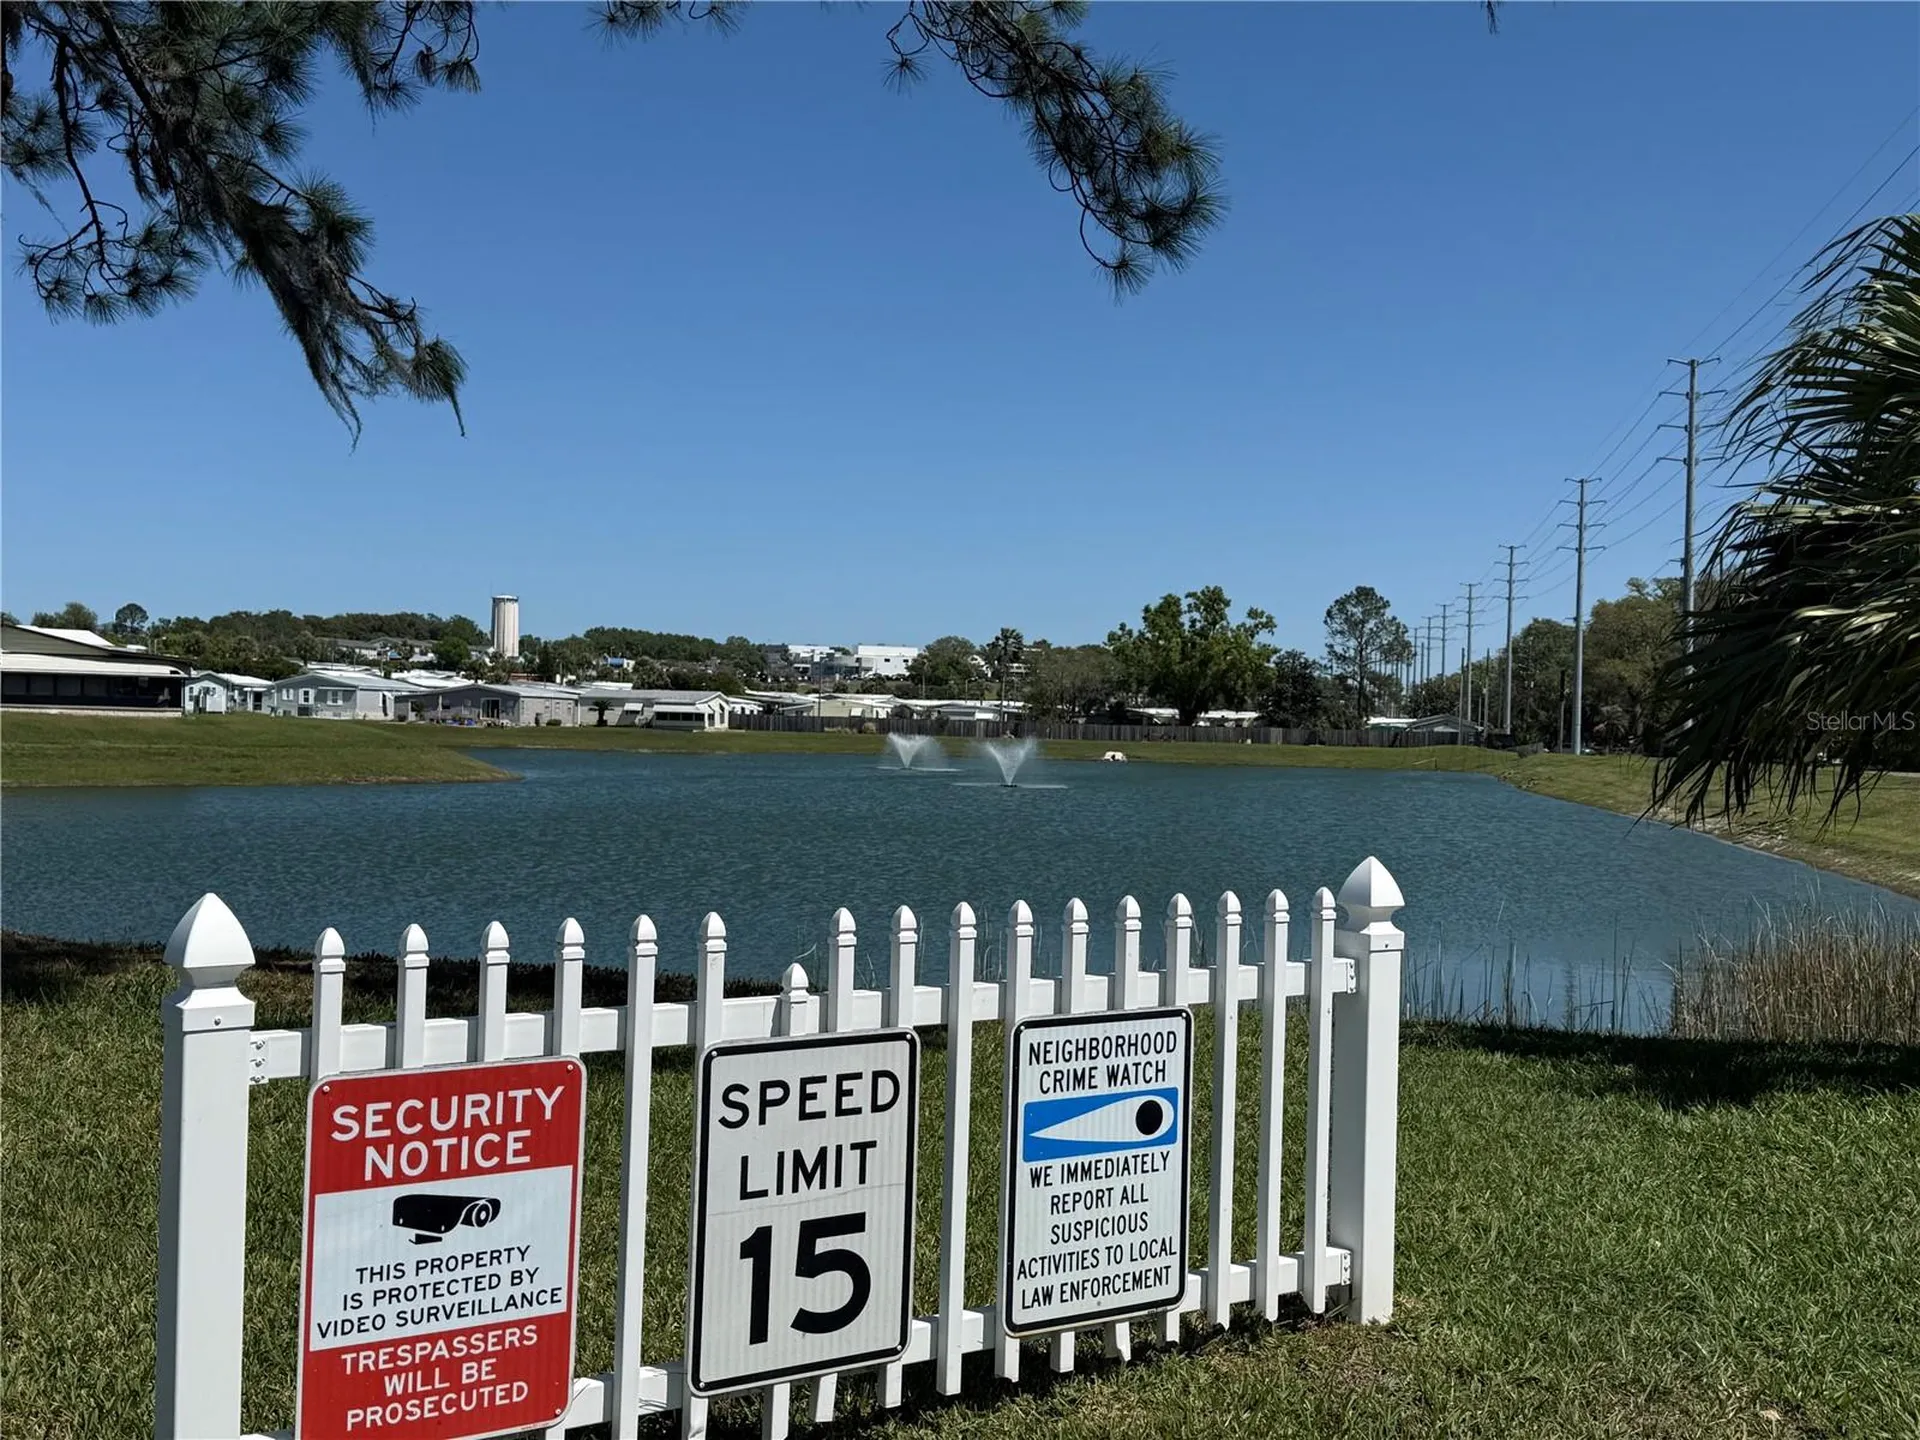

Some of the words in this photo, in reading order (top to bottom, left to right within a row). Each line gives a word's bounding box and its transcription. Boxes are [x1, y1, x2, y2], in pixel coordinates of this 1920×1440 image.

[1028, 1031, 1177, 1066] NEIGHBORHOOD
[718, 1070, 900, 1129] SPEED
[1039, 1067, 1098, 1094] CRIME
[1106, 1061, 1166, 1086] WATCH
[331, 1086, 564, 1142] SECURITY
[365, 1130, 531, 1181] NOTICE
[740, 1141, 877, 1200] LIMIT
[1030, 1165, 1053, 1188] WE
[1061, 1151, 1170, 1185] IMMEDIATELY
[1050, 1187, 1115, 1215] REPORT
[1120, 1183, 1148, 1205] ALL
[1050, 1212, 1148, 1245] SUSPICIOUS
[356, 1262, 406, 1284] THIS
[416, 1245, 531, 1277] PROPERTY
[739, 1212, 871, 1345] 15
[1017, 1243, 1099, 1281] ACTIVITIES
[1104, 1242, 1124, 1267] TO
[1130, 1237, 1177, 1262] LOCAL
[343, 1292, 362, 1311] IS
[373, 1274, 501, 1306] PROTECTED
[511, 1268, 539, 1285] BY
[1022, 1287, 1055, 1310] LAW
[1060, 1265, 1172, 1302] ENFORCEMENT
[317, 1314, 386, 1339] VIDEO
[396, 1287, 562, 1327] SURVEILLANCE
[342, 1325, 538, 1374] TRESPASSERS
[384, 1368, 450, 1396] WILL
[461, 1359, 497, 1382] BE
[347, 1381, 528, 1431] PROSECUTED
